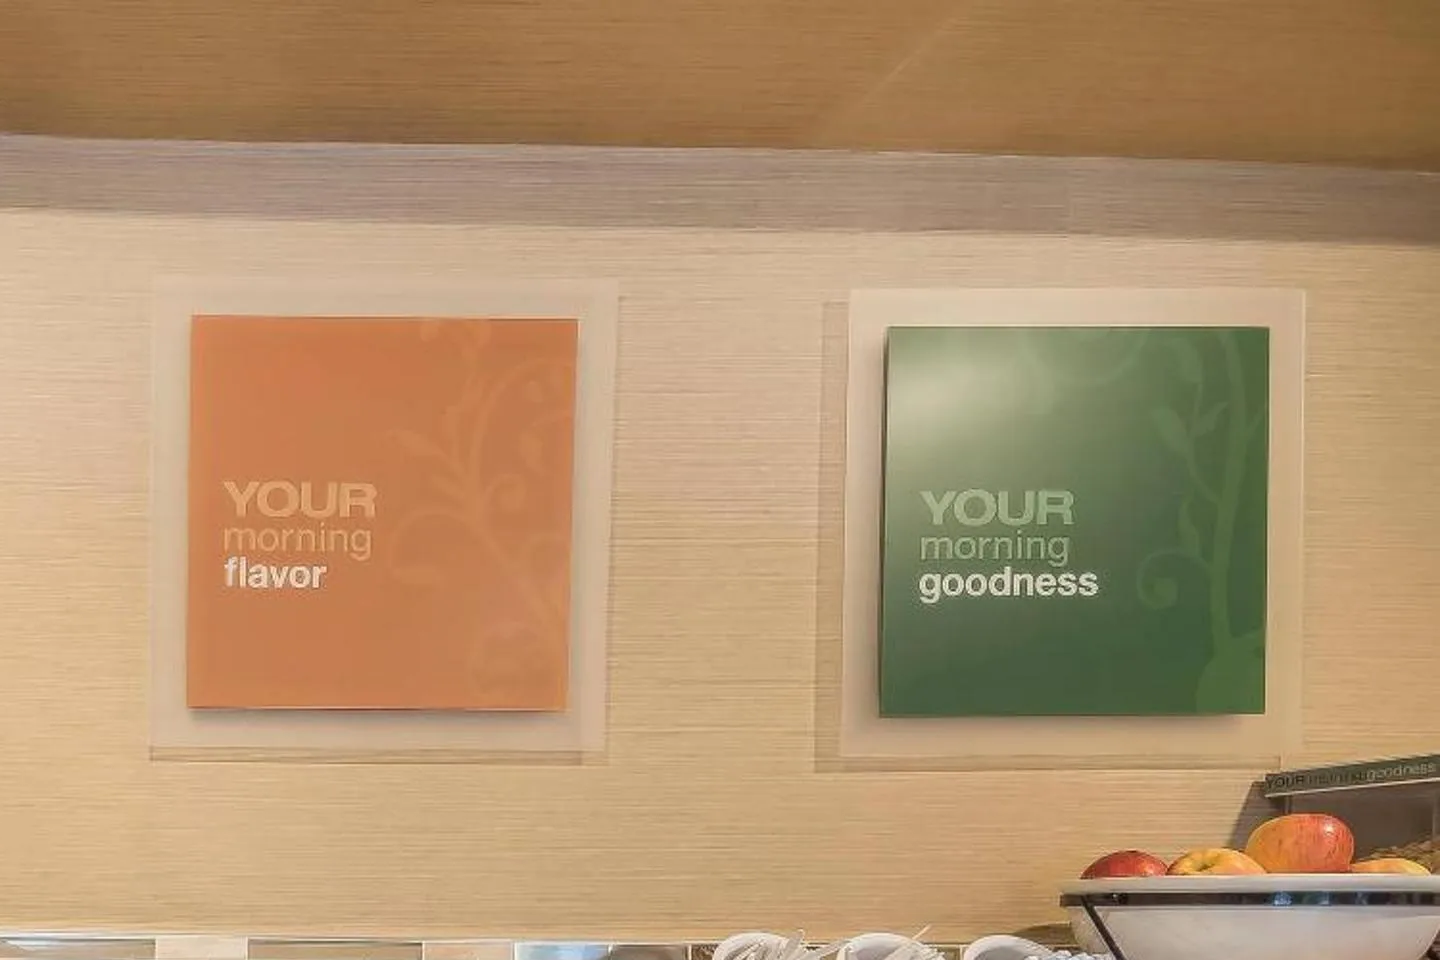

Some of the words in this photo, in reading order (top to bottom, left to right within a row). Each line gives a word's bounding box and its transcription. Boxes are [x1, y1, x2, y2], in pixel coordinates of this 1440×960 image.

[223, 480, 378, 519] YOUR
[919, 488, 1075, 527] YOUR
[224, 521, 372, 562] morning
[920, 529, 1070, 567] morning
[224, 556, 328, 588] flavor
[919, 566, 1100, 604] goodness
